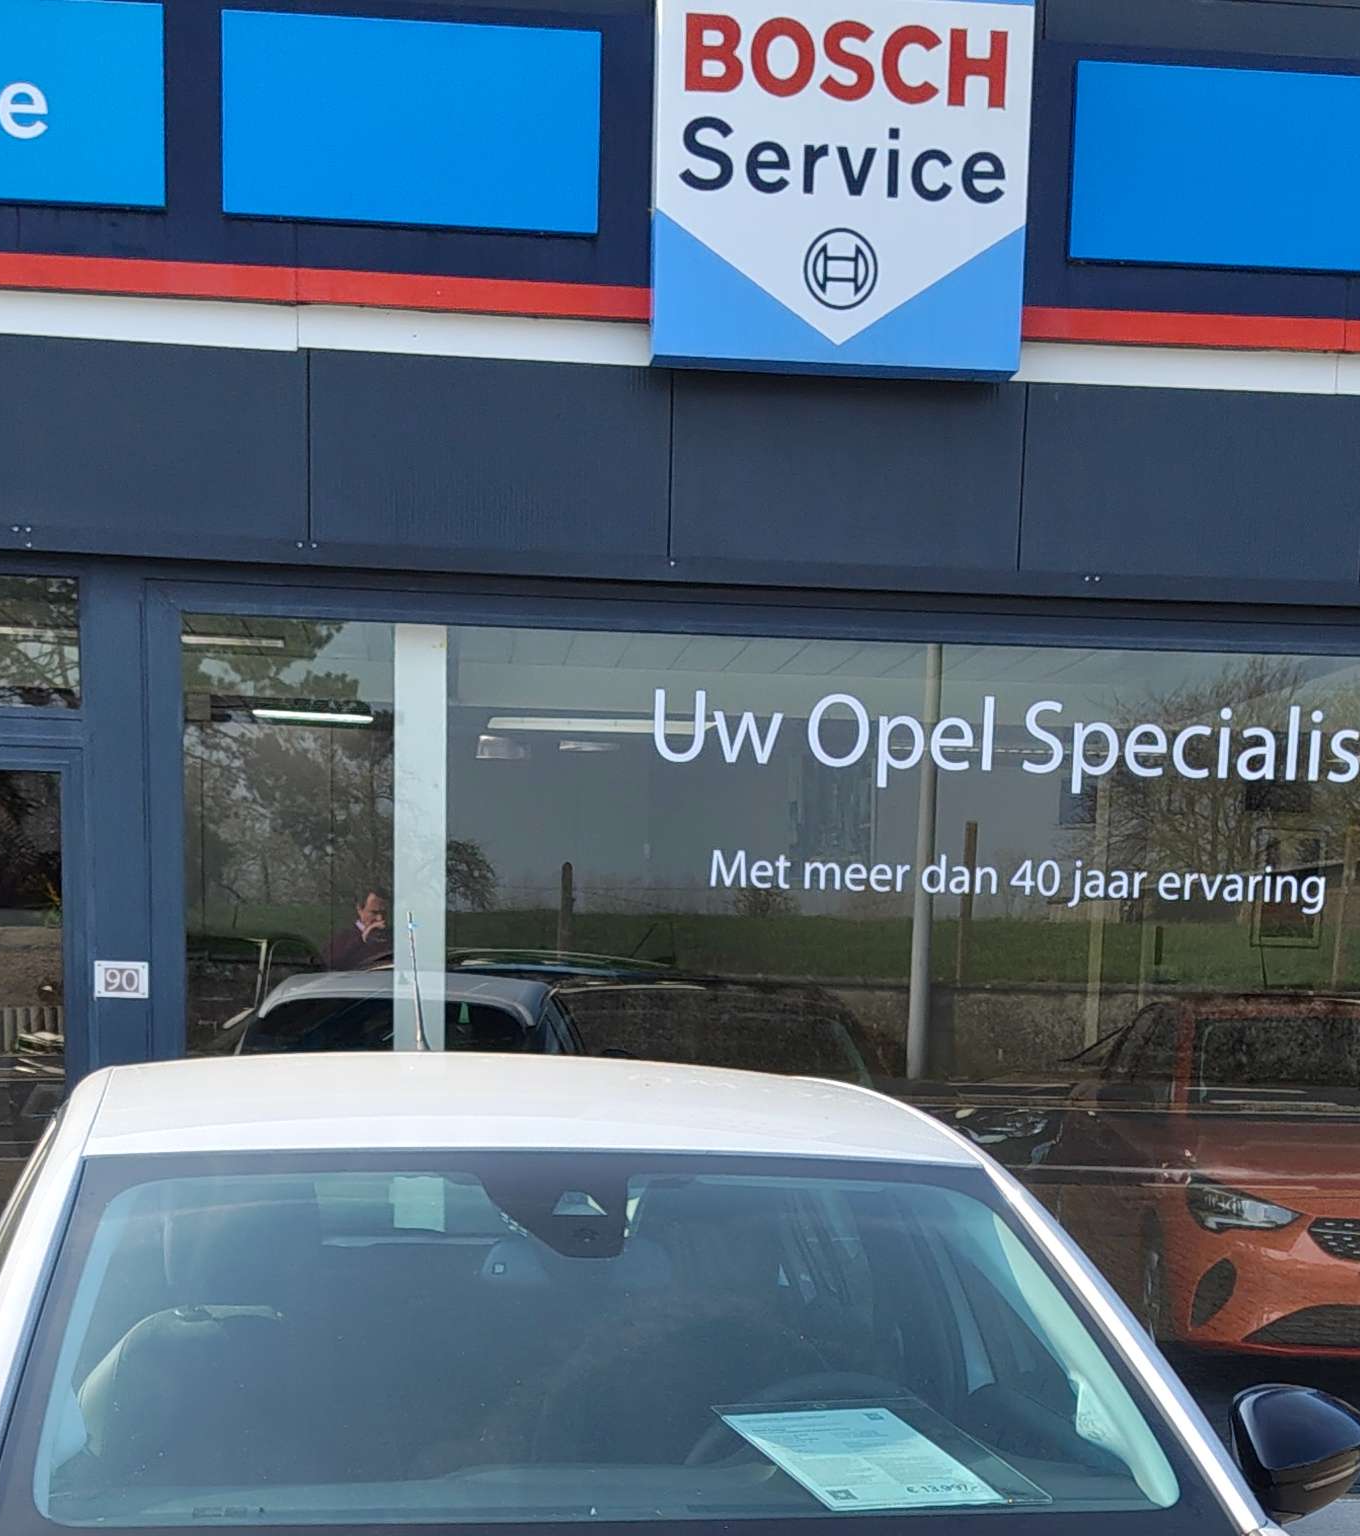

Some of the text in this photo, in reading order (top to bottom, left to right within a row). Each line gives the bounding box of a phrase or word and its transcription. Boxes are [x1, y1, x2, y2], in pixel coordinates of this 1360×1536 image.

[684, 12, 1009, 110] BOSCH
[679, 115, 1007, 204] Service
[652, 688, 784, 764] Uw
[806, 693, 995, 788] Opel
[708, 849, 1327, 914] Met meer dan 40 jaar ervaring
[106, 969, 138, 991] 90
